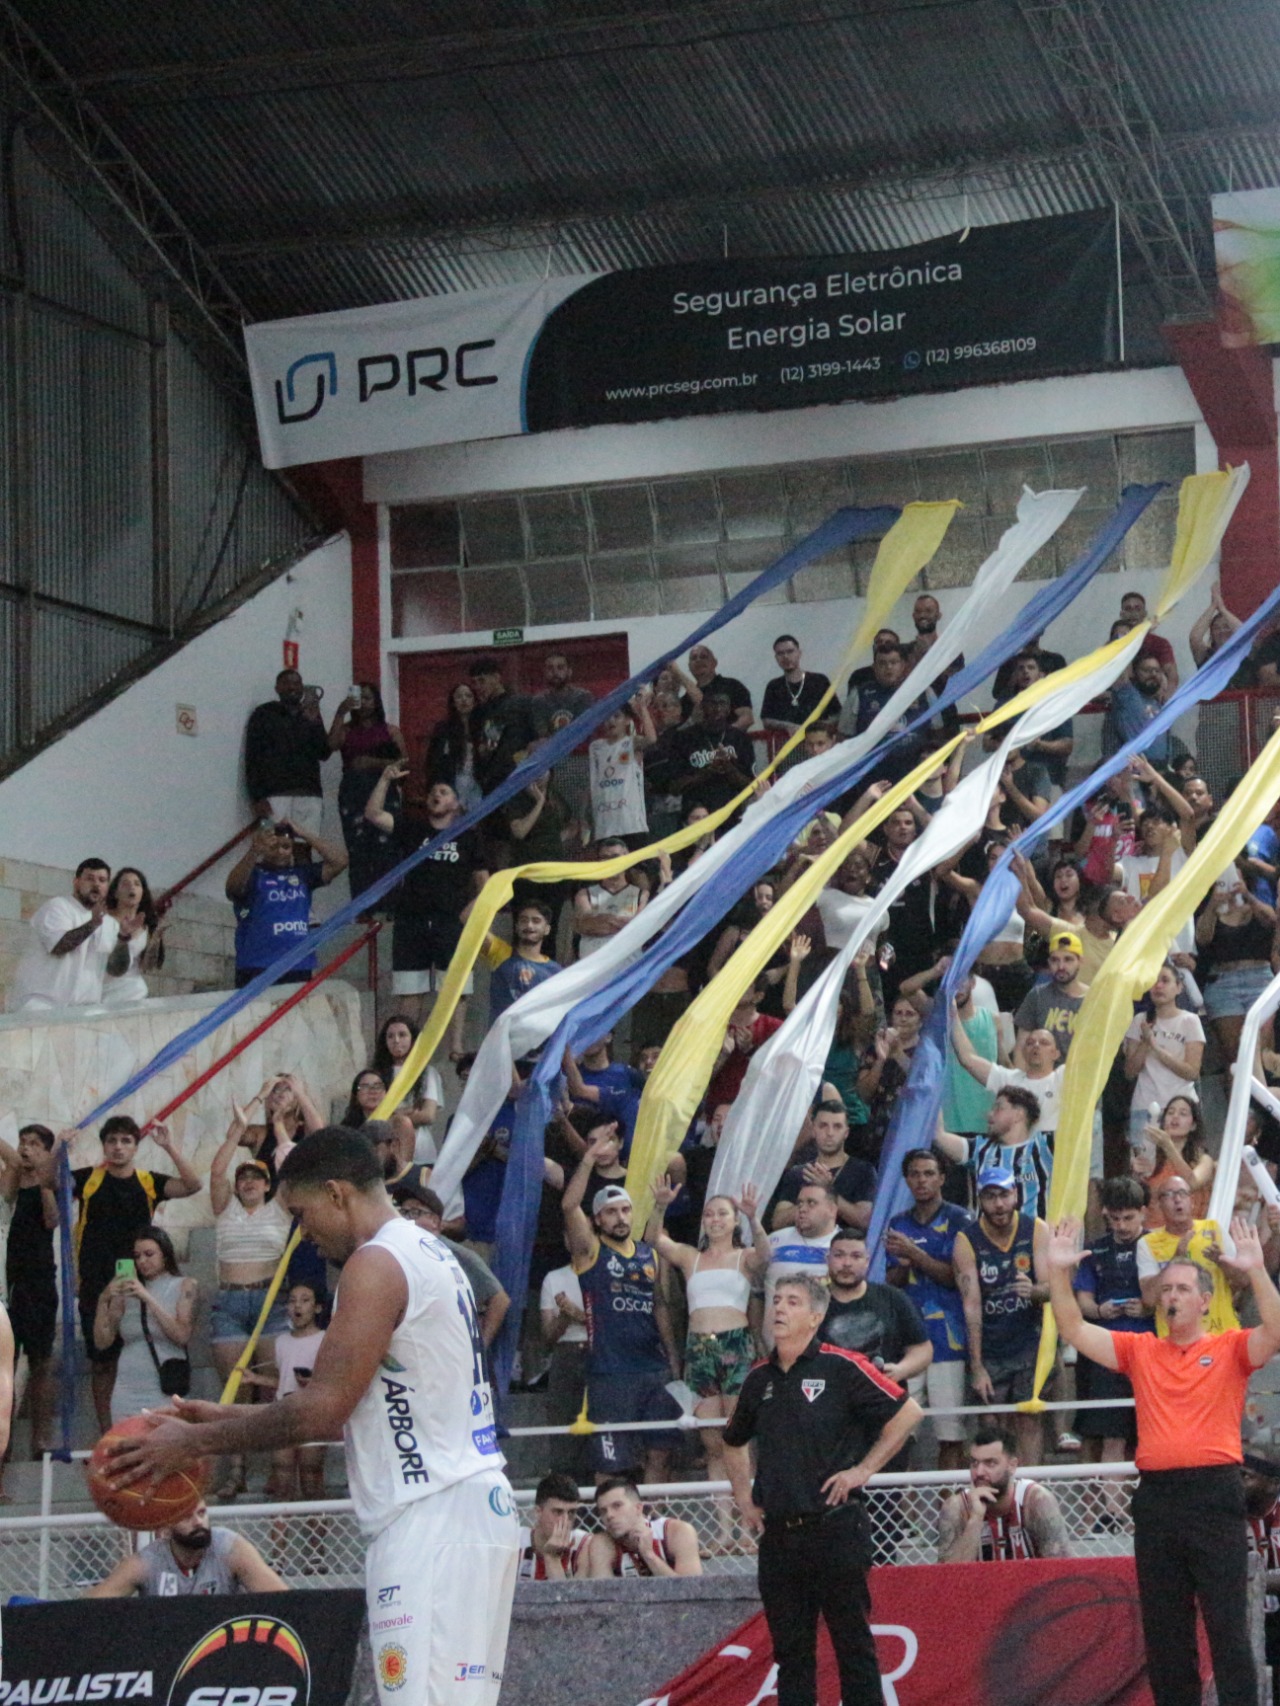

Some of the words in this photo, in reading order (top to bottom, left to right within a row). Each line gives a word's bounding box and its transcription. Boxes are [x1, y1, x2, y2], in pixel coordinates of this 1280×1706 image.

[673, 277, 818, 316] Segurança
[826, 260, 963, 298] Eletrônica
[727, 320, 831, 351] Energia
[838, 309, 907, 338] Solar
[925, 346, 951, 366] (12)
[953, 335, 1037, 361] 996368109
[358, 338, 498, 402] PRC
[605, 370, 758, 402] www.prcseg.com.br
[780, 364, 805, 384] (12)
[807, 355, 881, 379] 3199-1443
[381, 1375, 430, 1485] ÁRBORE
